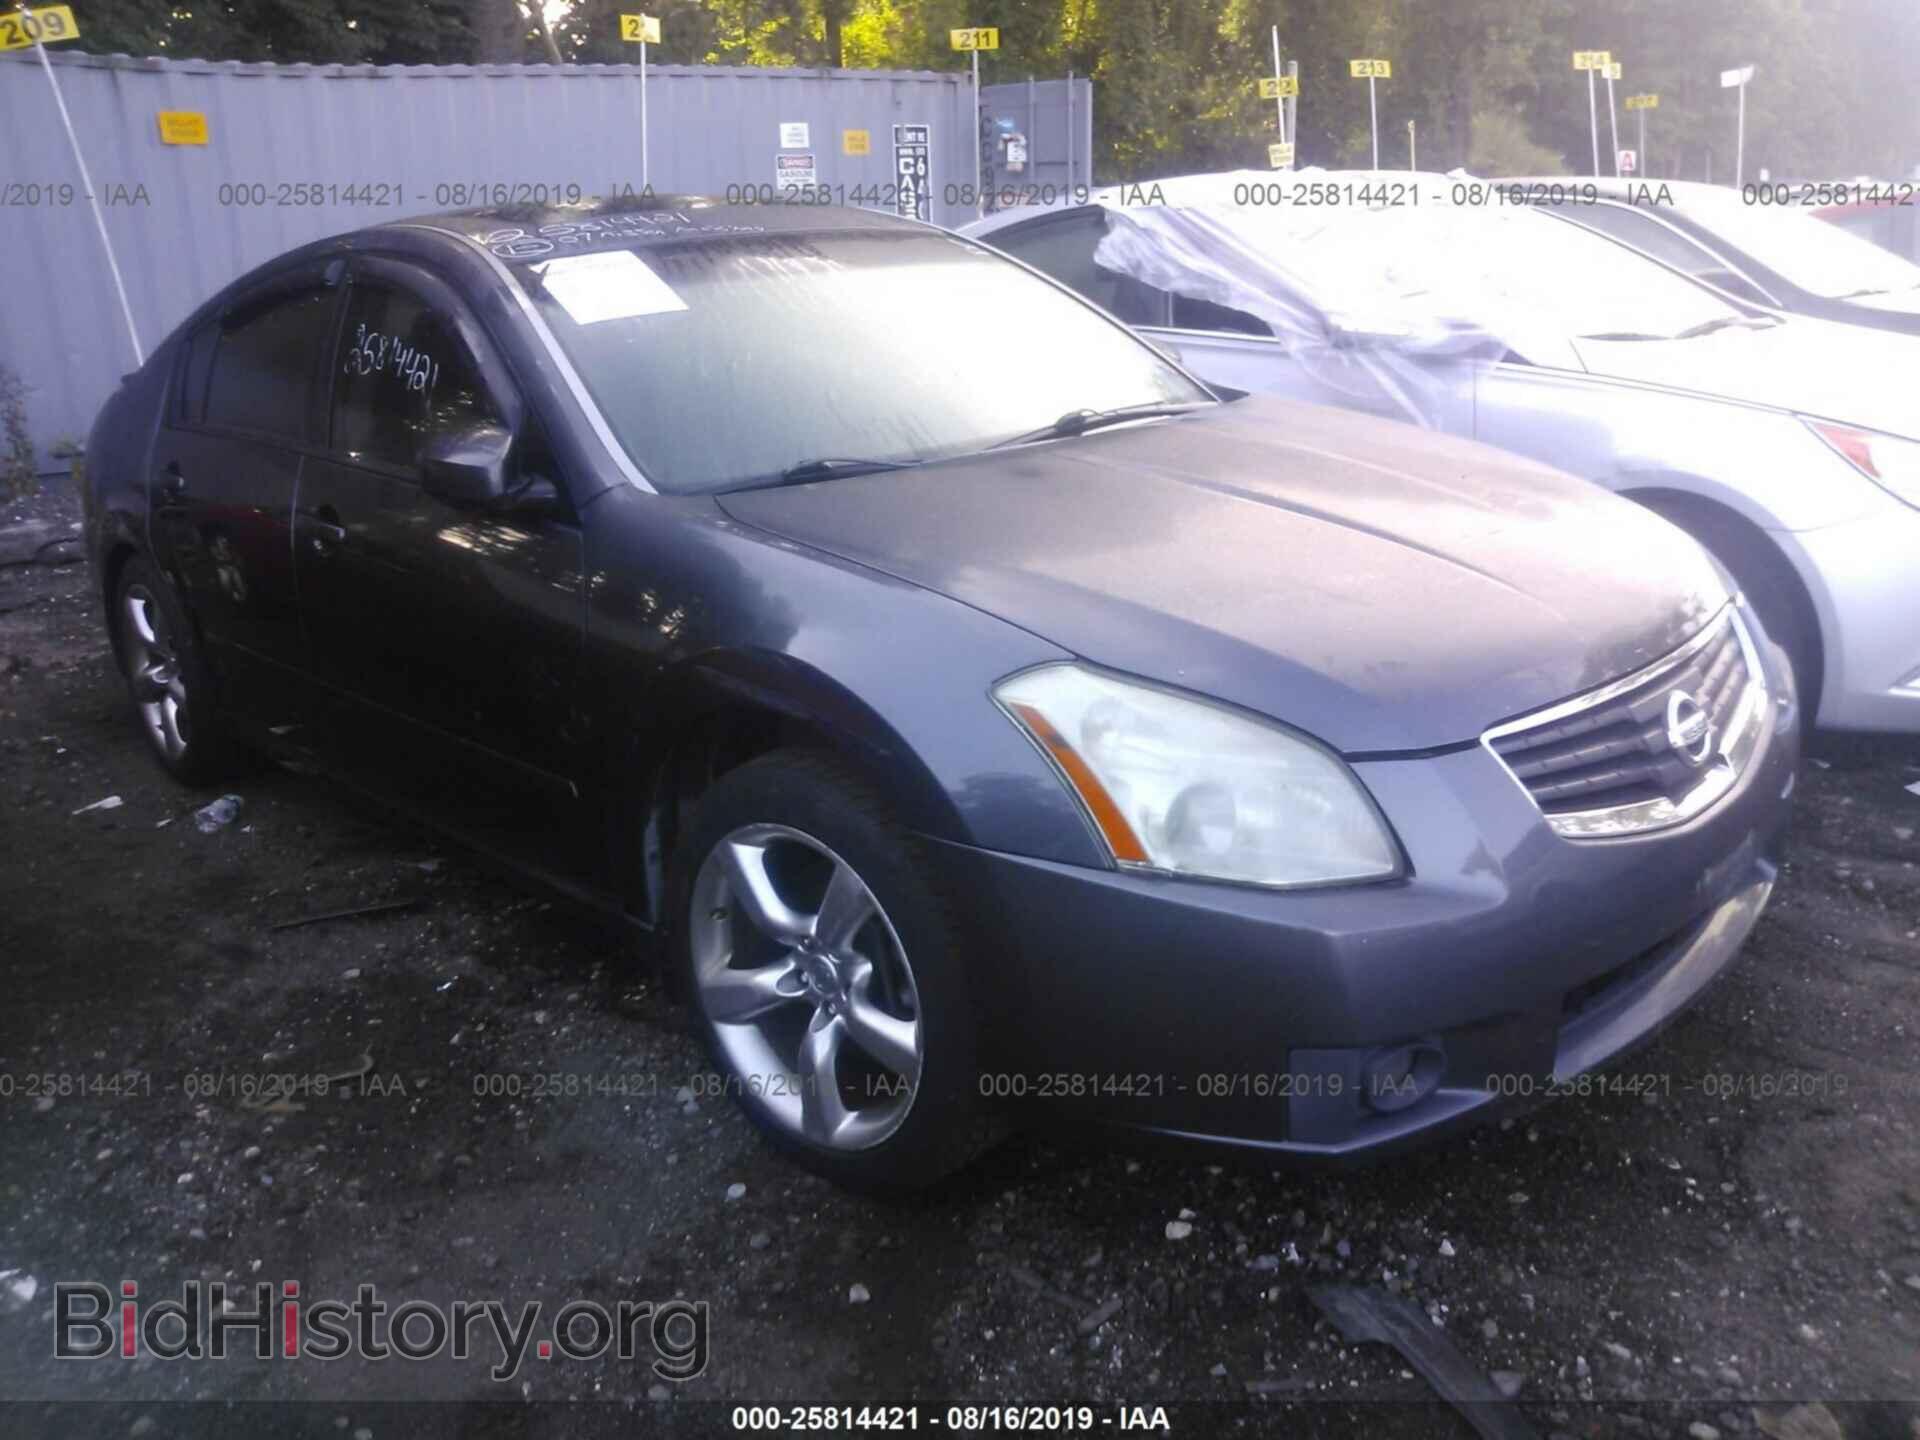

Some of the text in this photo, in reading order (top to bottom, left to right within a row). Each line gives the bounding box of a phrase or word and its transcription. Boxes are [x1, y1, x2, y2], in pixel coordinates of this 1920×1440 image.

[0, 11, 66, 45] 209
[959, 30, 992, 47] 211
[1266, 80, 1292, 97] 22
